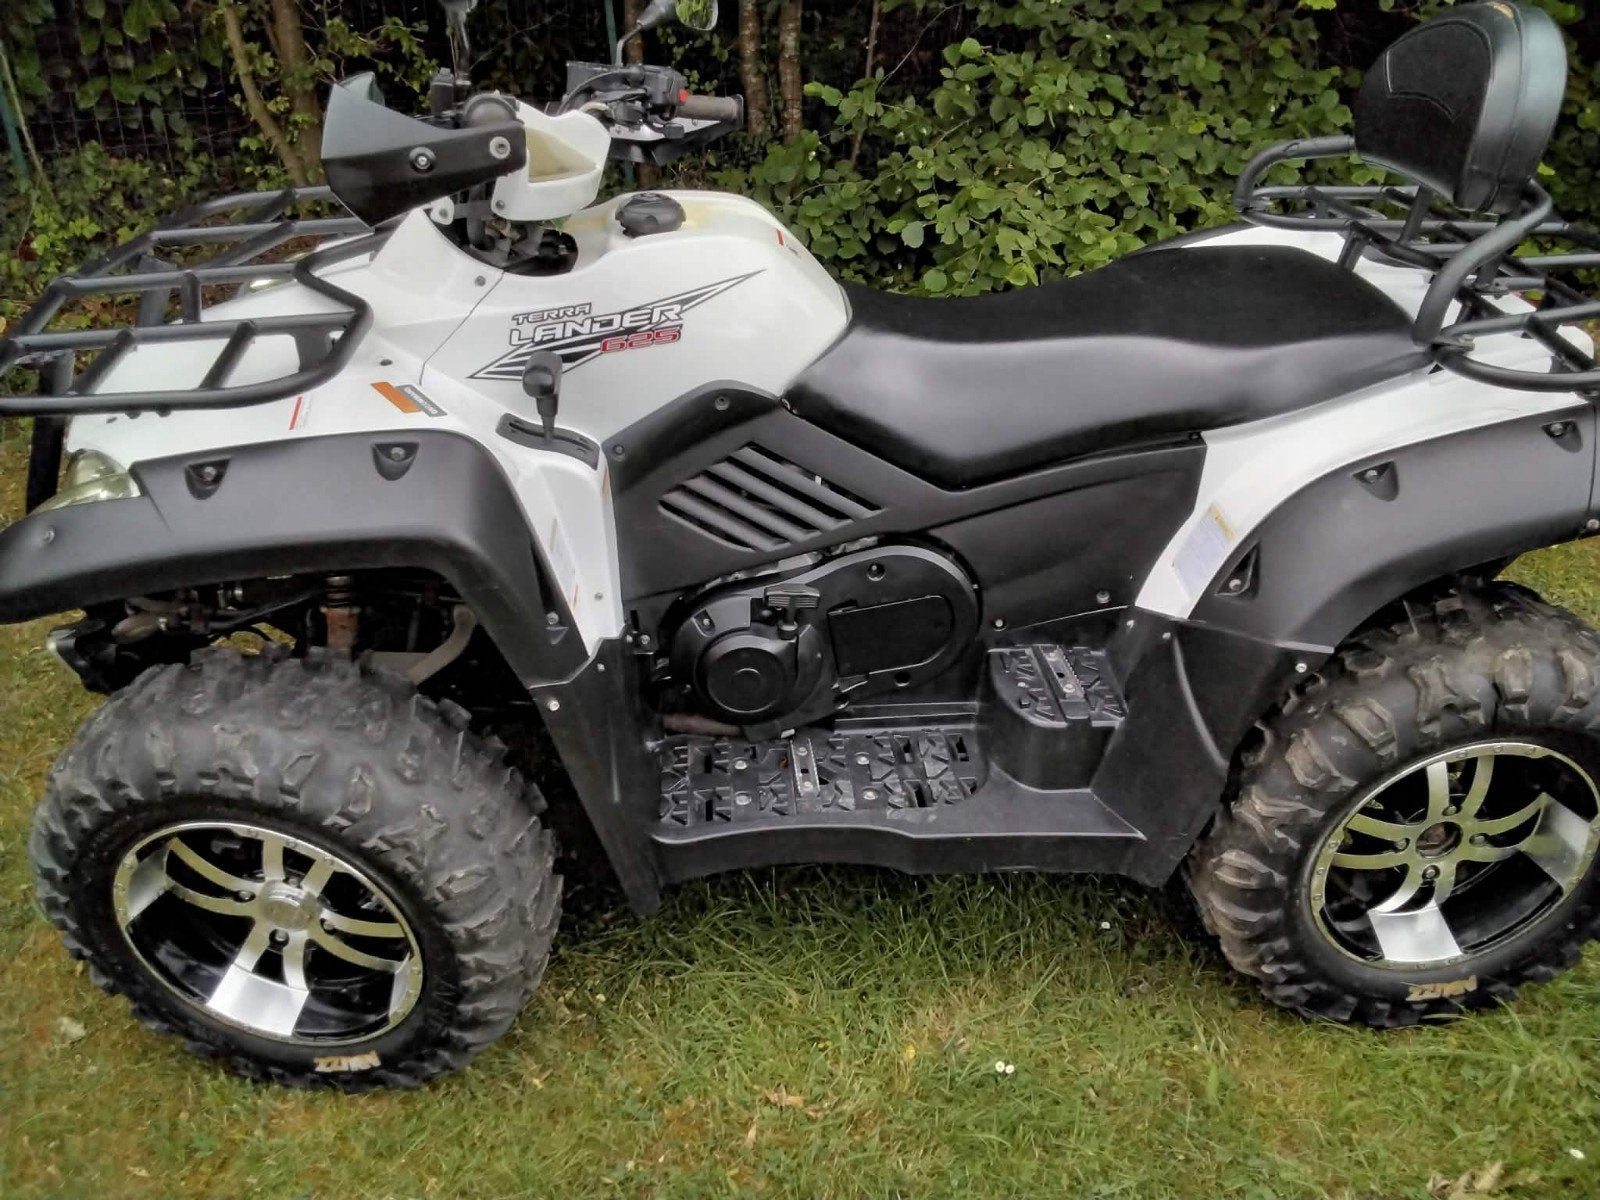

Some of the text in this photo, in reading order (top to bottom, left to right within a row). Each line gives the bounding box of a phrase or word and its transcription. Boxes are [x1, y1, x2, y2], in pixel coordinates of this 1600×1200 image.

[509, 304, 684, 346] LANDER
[512, 303, 592, 325] TERRA
[601, 326, 682, 352] 625
